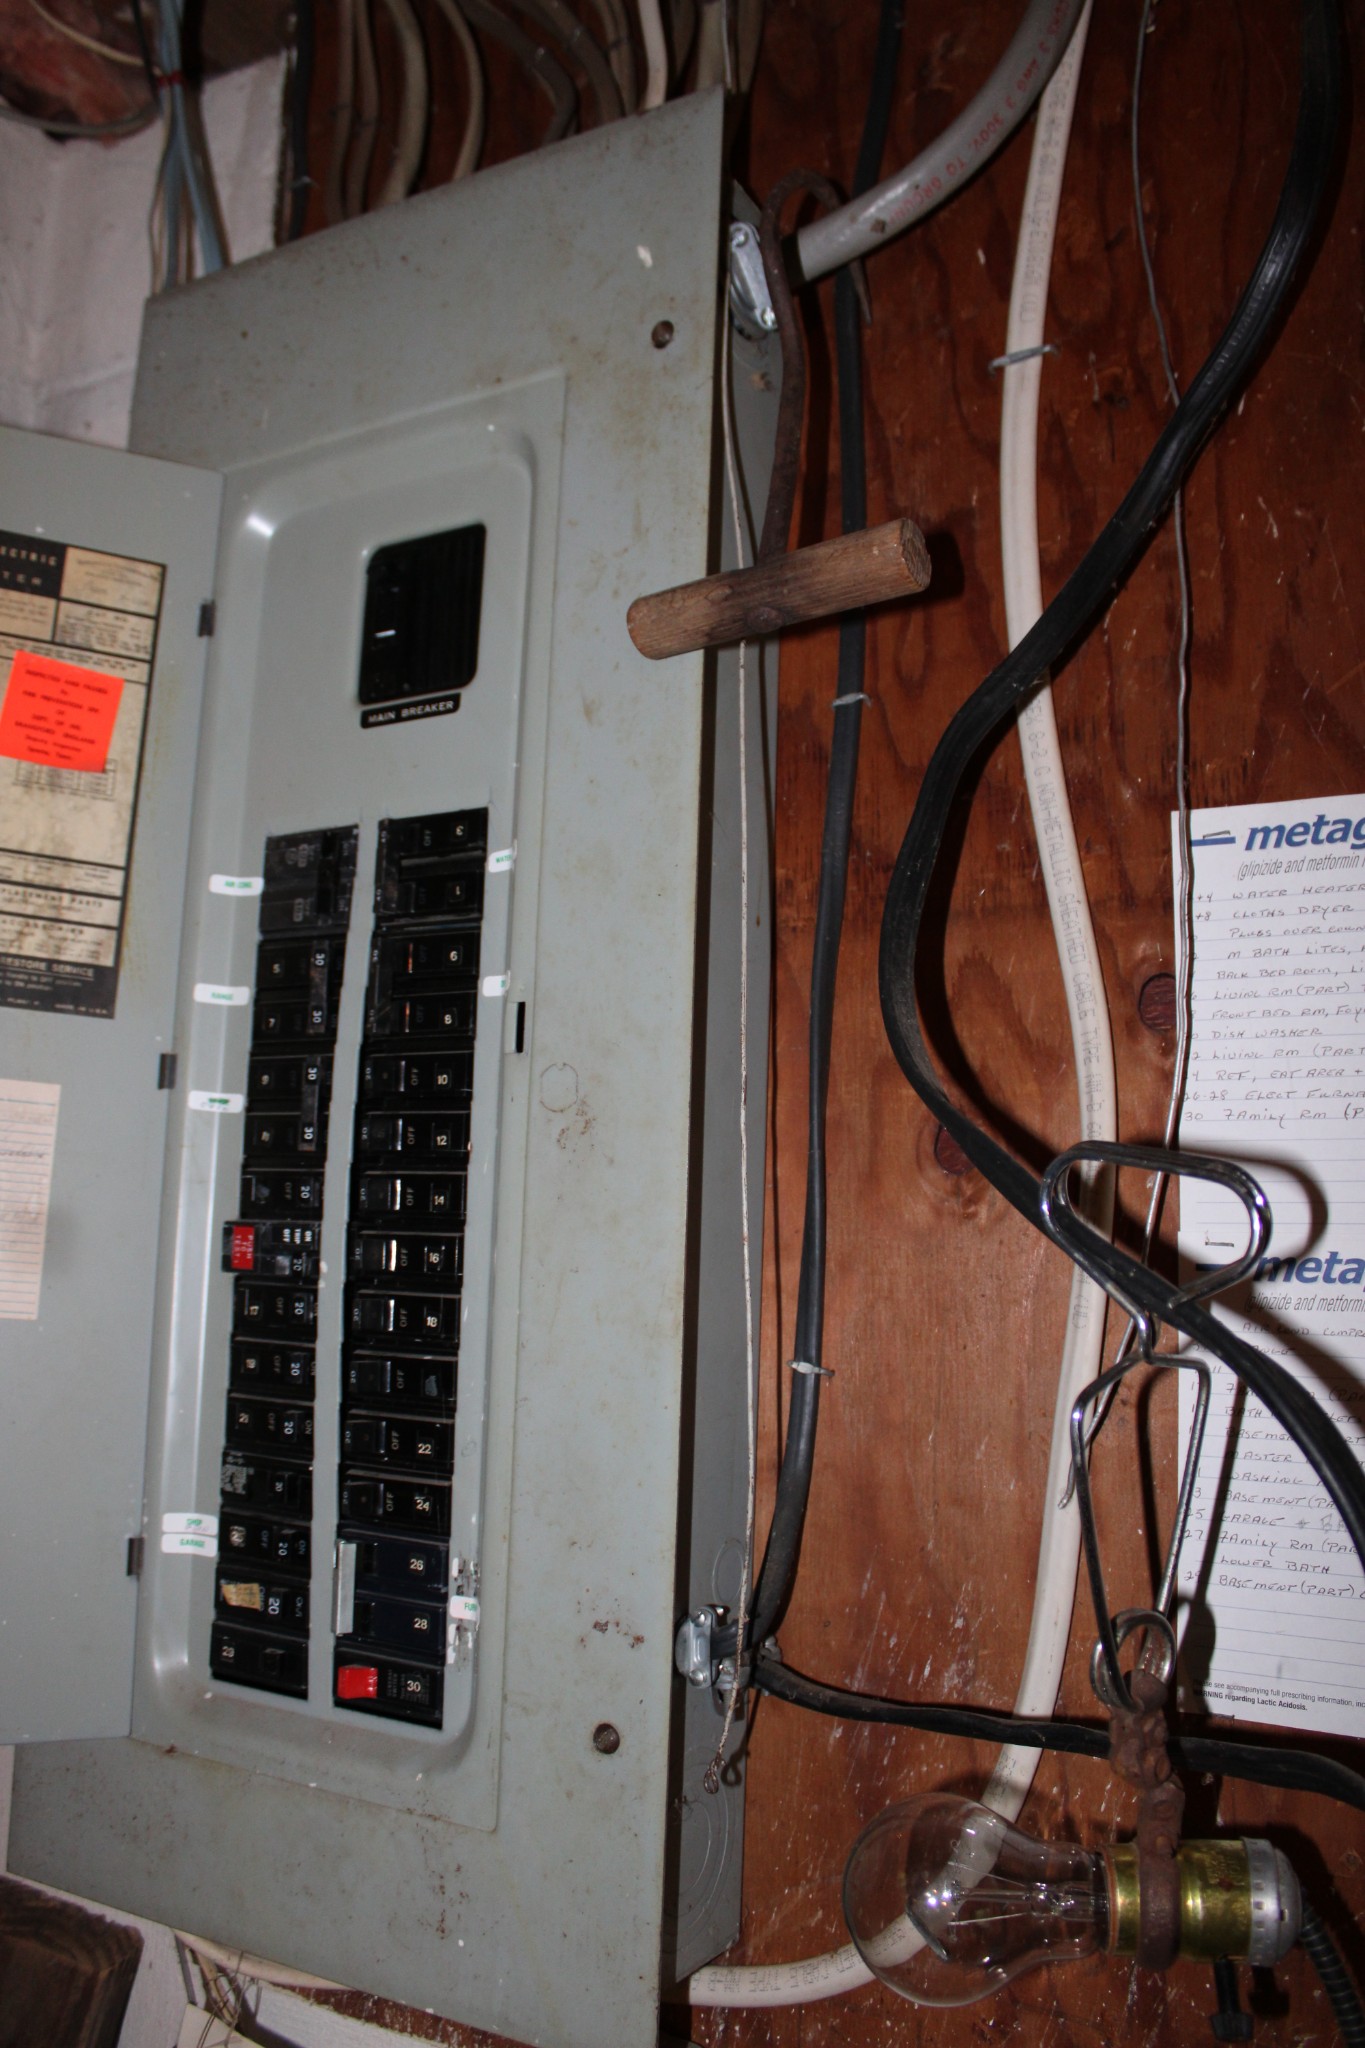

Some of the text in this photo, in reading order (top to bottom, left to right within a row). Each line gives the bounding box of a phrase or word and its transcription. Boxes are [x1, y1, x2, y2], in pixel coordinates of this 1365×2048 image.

[368, 700, 454, 724] MAIN BREAKER
[1244, 814, 1365, 852] metag
[1284, 856, 1306, 874] and
[1306, 851, 1361, 873] metformin
[1233, 883, 1365, 900] WATER HEATER
[1298, 903, 1356, 921] DRYER
[1056, 892, 1088, 965] SHEATHED
[1283, 926, 1322, 937] OVER
[314, 952, 326, 967] 30
[449, 949, 459, 962] 6
[1252, 946, 1291, 959] BATH
[1260, 965, 1287, 977] BED
[1071, 973, 1096, 1020] CABLE
[312, 1009, 323, 1024] 30
[1212, 1009, 1257, 1020] FRONT
[1262, 1008, 1292, 1019] BED
[1255, 1027, 1324, 1039] WASHER
[1079, 1029, 1102, 1066] TYPE
[306, 1066, 318, 1081] 30
[410, 1067, 419, 1087] OFF
[436, 1073, 449, 1086] 10
[1270, 1068, 1303, 1080] EAT
[1245, 1090, 1298, 1101] ELECT
[1184, 1111, 1204, 1120] 30
[303, 1125, 315, 1140] 30
[407, 1126, 416, 1146] OFF
[436, 1134, 448, 1147] 12
[300, 1185, 311, 1199] 20
[405, 1186, 415, 1207] OFF
[434, 1194, 446, 1207] 14
[282, 1228, 291, 1243] OFF
[304, 1230, 313, 1243] ON
[400, 1246, 409, 1268] OFF
[428, 1251, 441, 1264] 16
[1253, 1250, 1365, 1294] meta
[293, 1301, 305, 1316] 20
[1294, 1294, 1318, 1313] and
[400, 1307, 409, 1329] OFF
[425, 1315, 439, 1328] 18
[290, 1361, 301, 1377] 20
[396, 1368, 406, 1390] OFF
[283, 1420, 295, 1436] 20
[391, 1430, 400, 1452] OFF
[417, 1442, 432, 1455] 22
[386, 1491, 395, 1512] OFF
[416, 1499, 430, 1512] 24
[1184, 1529, 1204, 1541] 27
[277, 1541, 289, 1556] 20
[409, 1558, 424, 1571] 26
[1220, 1555, 1331, 1575] LOWER BATH
[267, 1597, 280, 1616] 20
[413, 1617, 428, 1631] 28
[406, 1680, 421, 1693] 30
[1214, 1682, 1225, 1690] see
[1226, 1682, 1270, 1698] accompanying
[1270, 1687, 1281, 1697] full
[1281, 1689, 1316, 1703] prescribing
[1317, 1694, 1355, 1709] information,
[1225, 1693, 1309, 1712] regarding Lactic Acidosis.
